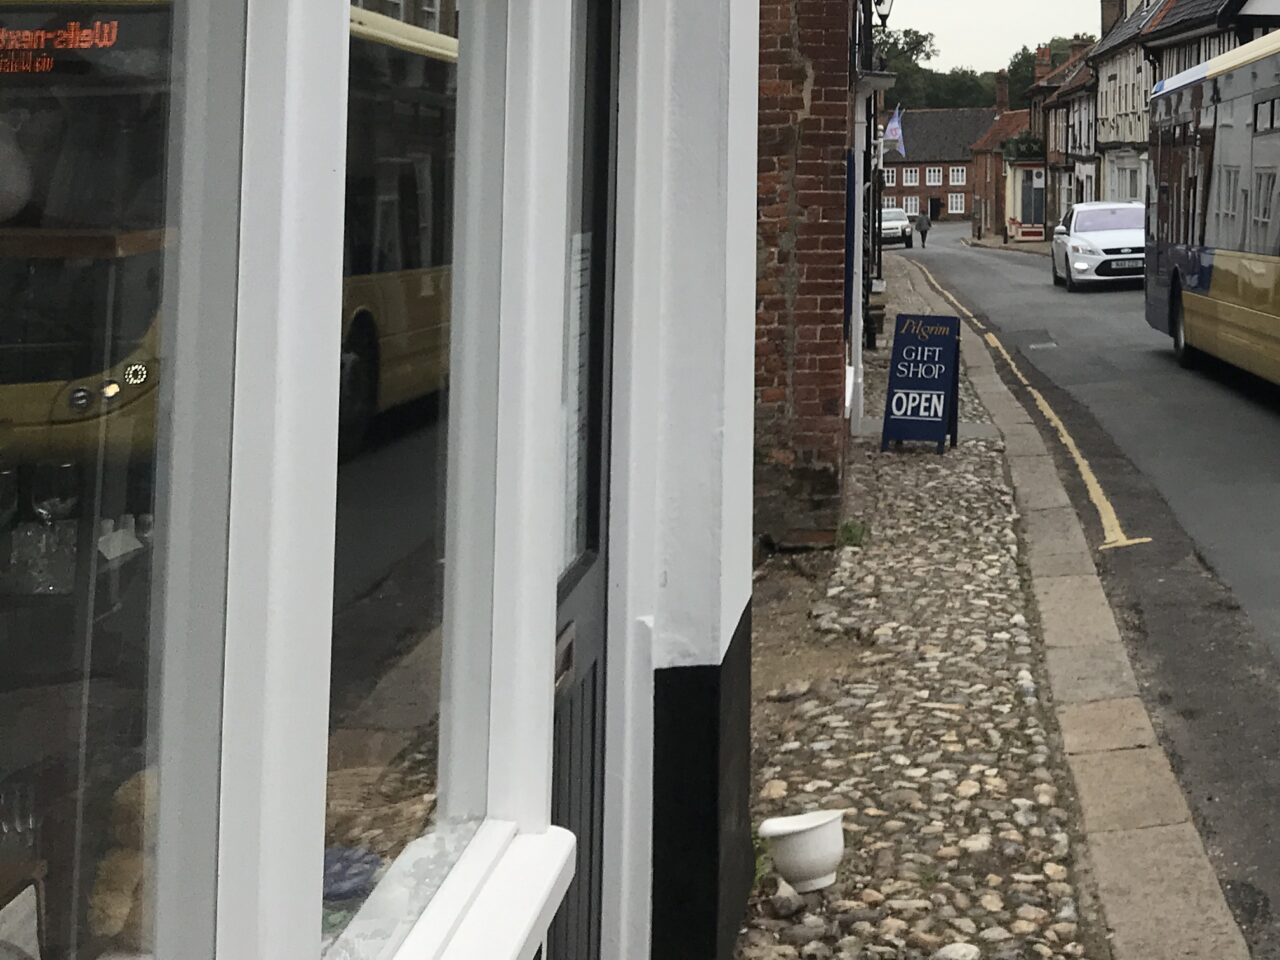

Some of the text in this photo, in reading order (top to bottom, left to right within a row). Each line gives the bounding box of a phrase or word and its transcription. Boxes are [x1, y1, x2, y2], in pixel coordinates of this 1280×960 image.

[899, 318, 950, 341] Pilgrim
[903, 345, 943, 362] GIFT
[896, 362, 946, 379] SHOP
[891, 392, 945, 418] OPEN
